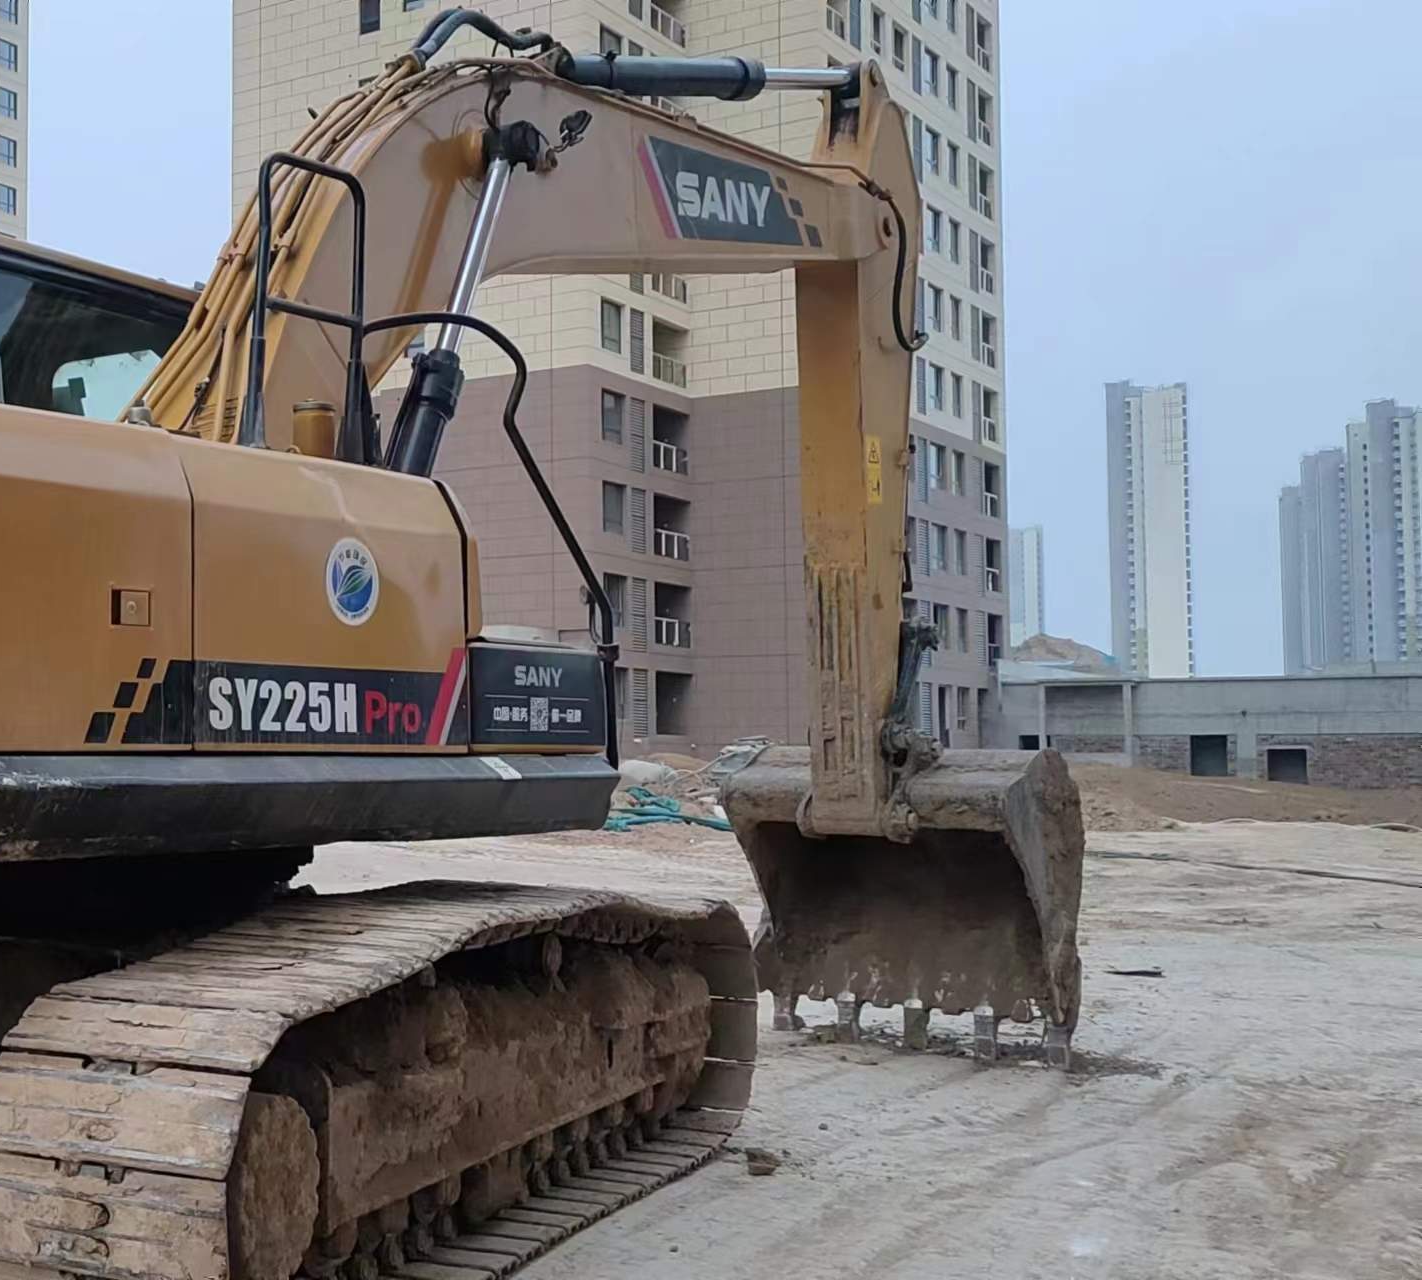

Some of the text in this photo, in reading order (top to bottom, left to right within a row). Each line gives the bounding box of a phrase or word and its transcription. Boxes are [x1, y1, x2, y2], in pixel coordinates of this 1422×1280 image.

[675, 171, 771, 228] SANY
[514, 665, 563, 688] SANY
[208, 676, 421, 736] SY225H Pro
